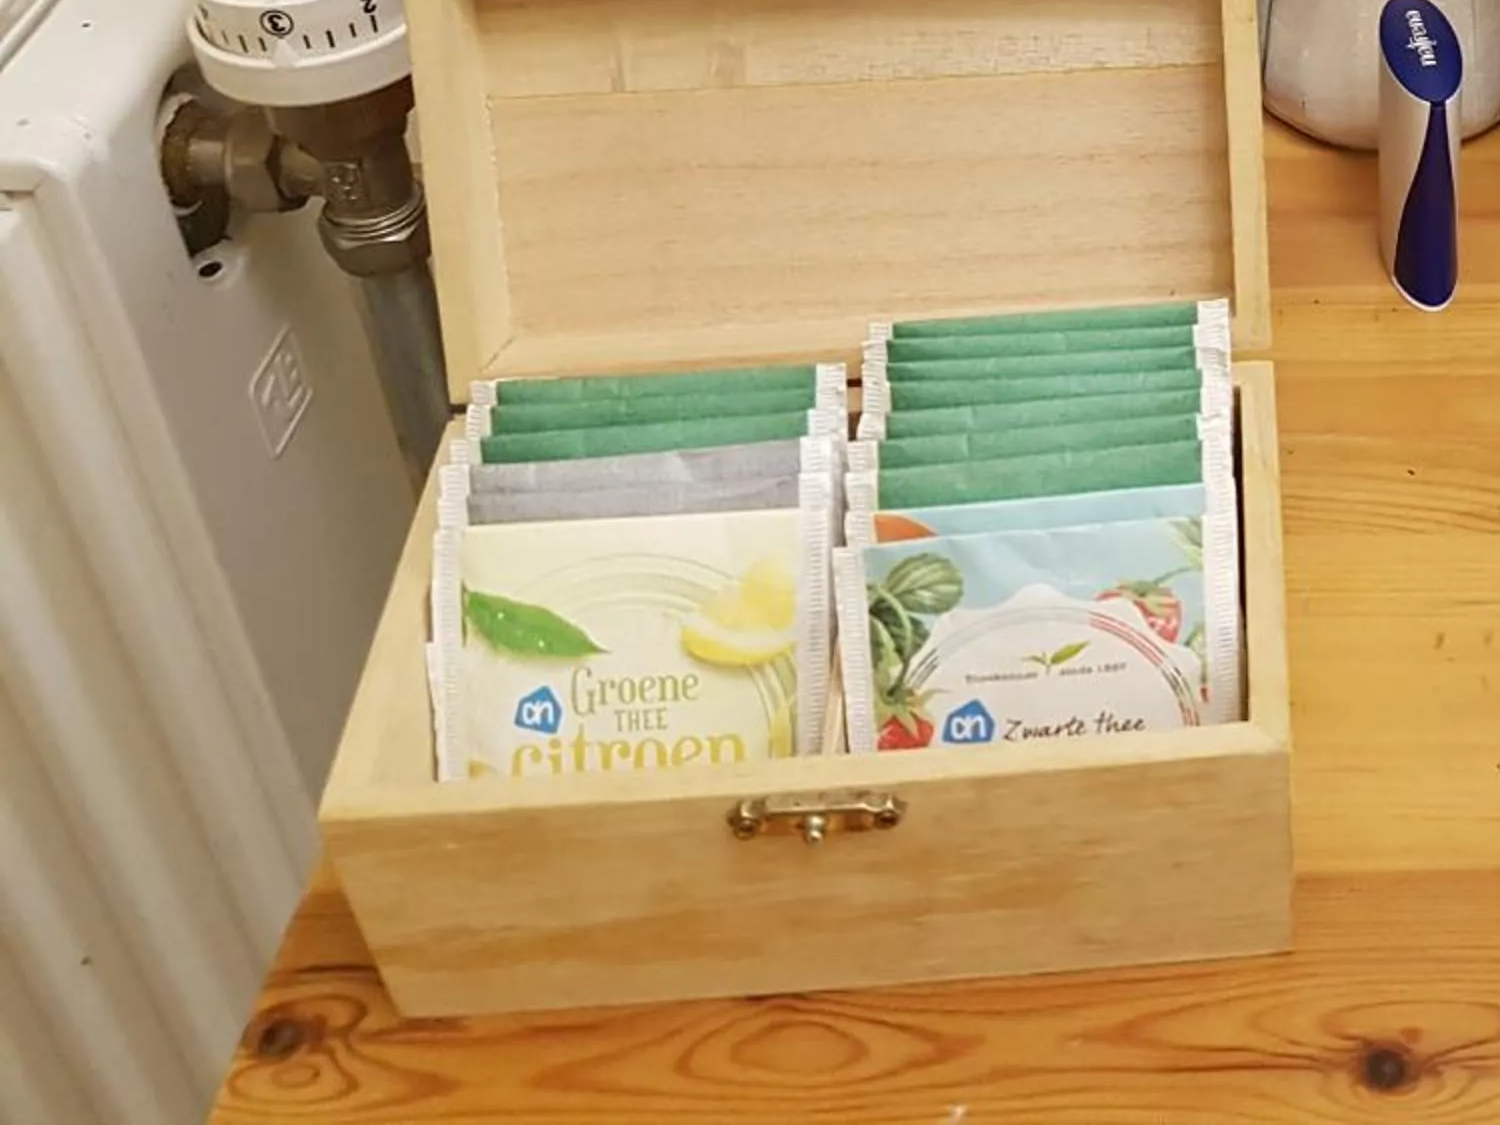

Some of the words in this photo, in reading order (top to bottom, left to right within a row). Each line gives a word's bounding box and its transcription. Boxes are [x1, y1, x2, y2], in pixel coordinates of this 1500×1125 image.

[570, 666, 699, 717] Groene
[613, 707, 669, 732] THEE
[1002, 716, 1088, 742] Zwarte
[1093, 710, 1146, 735] thee
